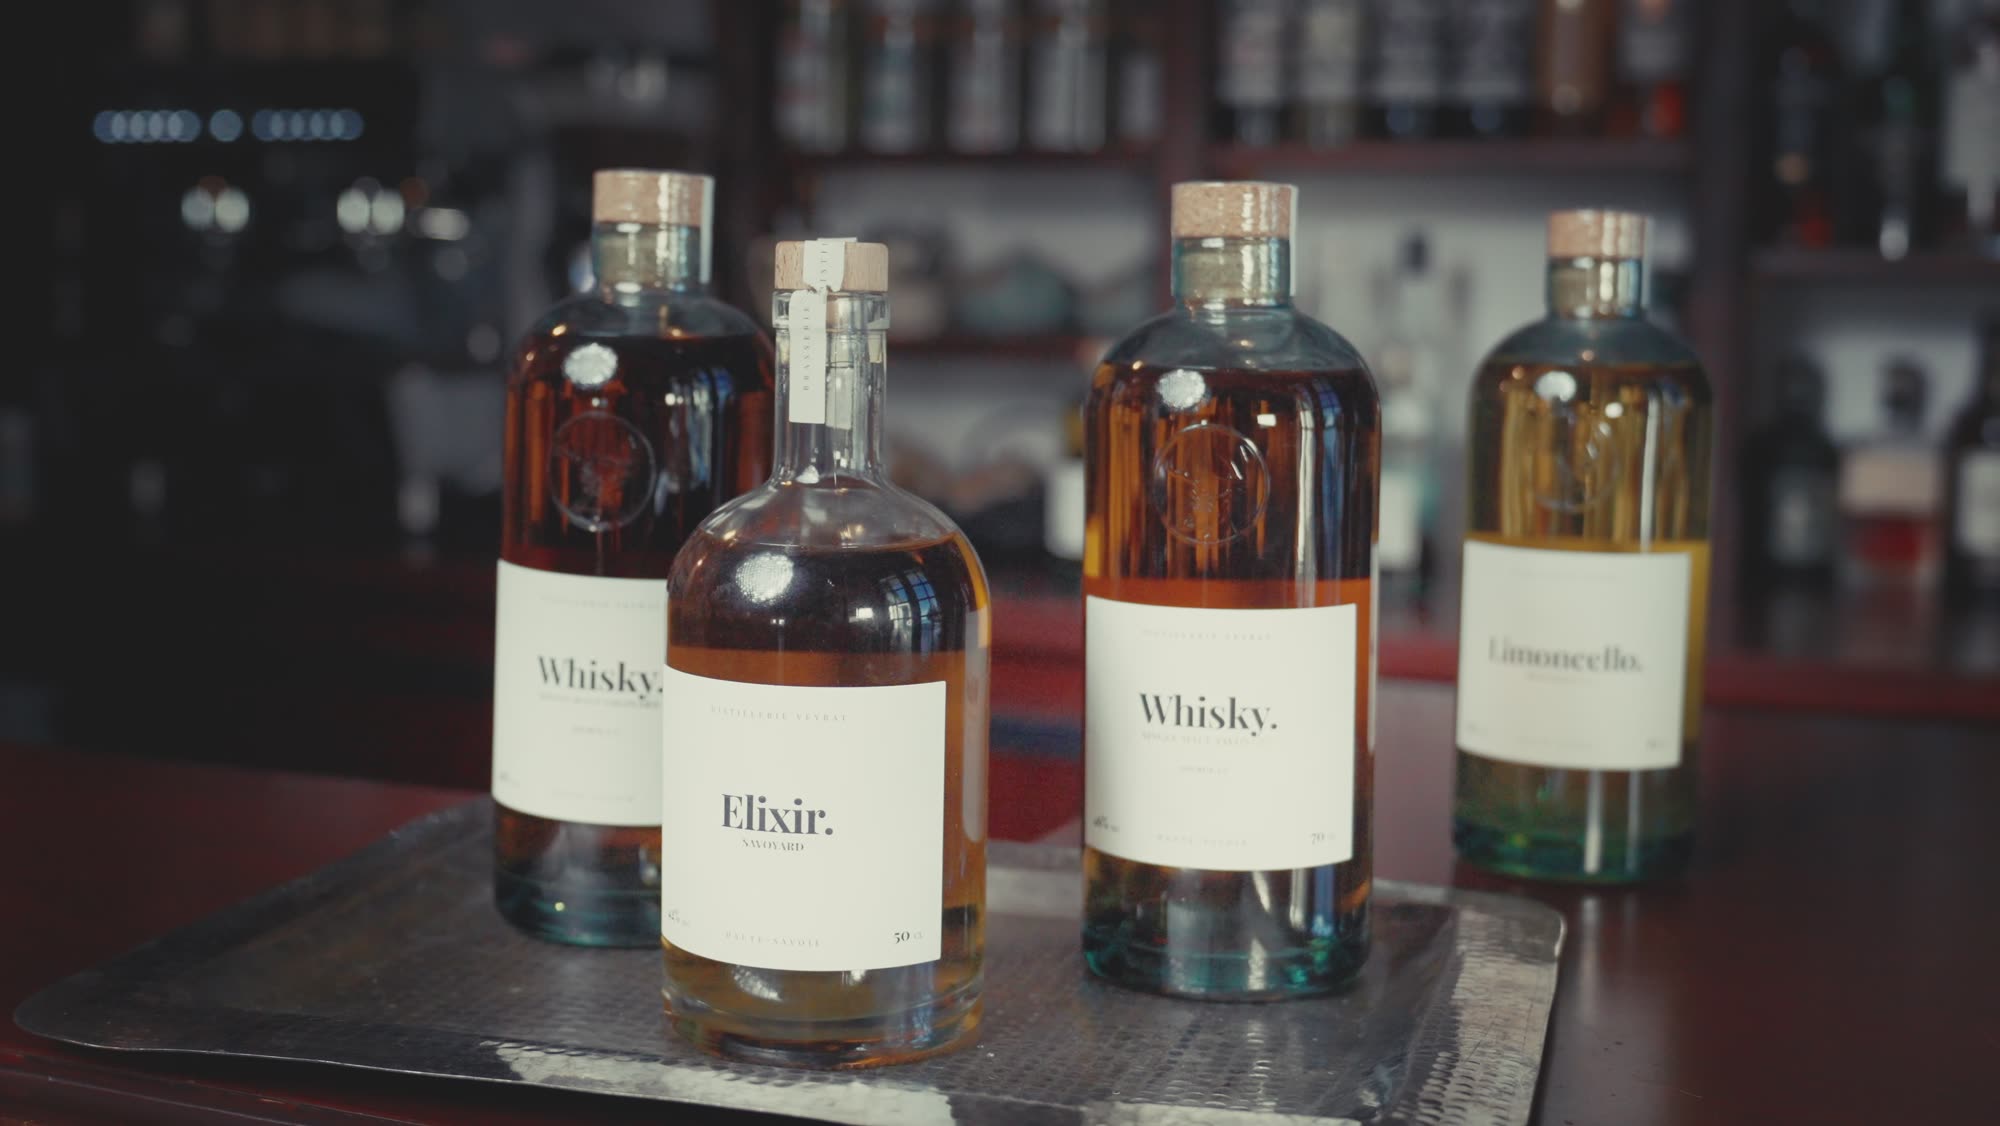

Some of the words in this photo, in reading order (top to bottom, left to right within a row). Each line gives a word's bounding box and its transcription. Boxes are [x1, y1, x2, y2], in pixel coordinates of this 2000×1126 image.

[537, 655, 663, 701] Whisky.
[1138, 692, 1278, 738] Whisky.
[721, 794, 834, 836] Elixir.
[742, 839, 804, 852] SAVOYARD
[893, 931, 910, 945] 50
